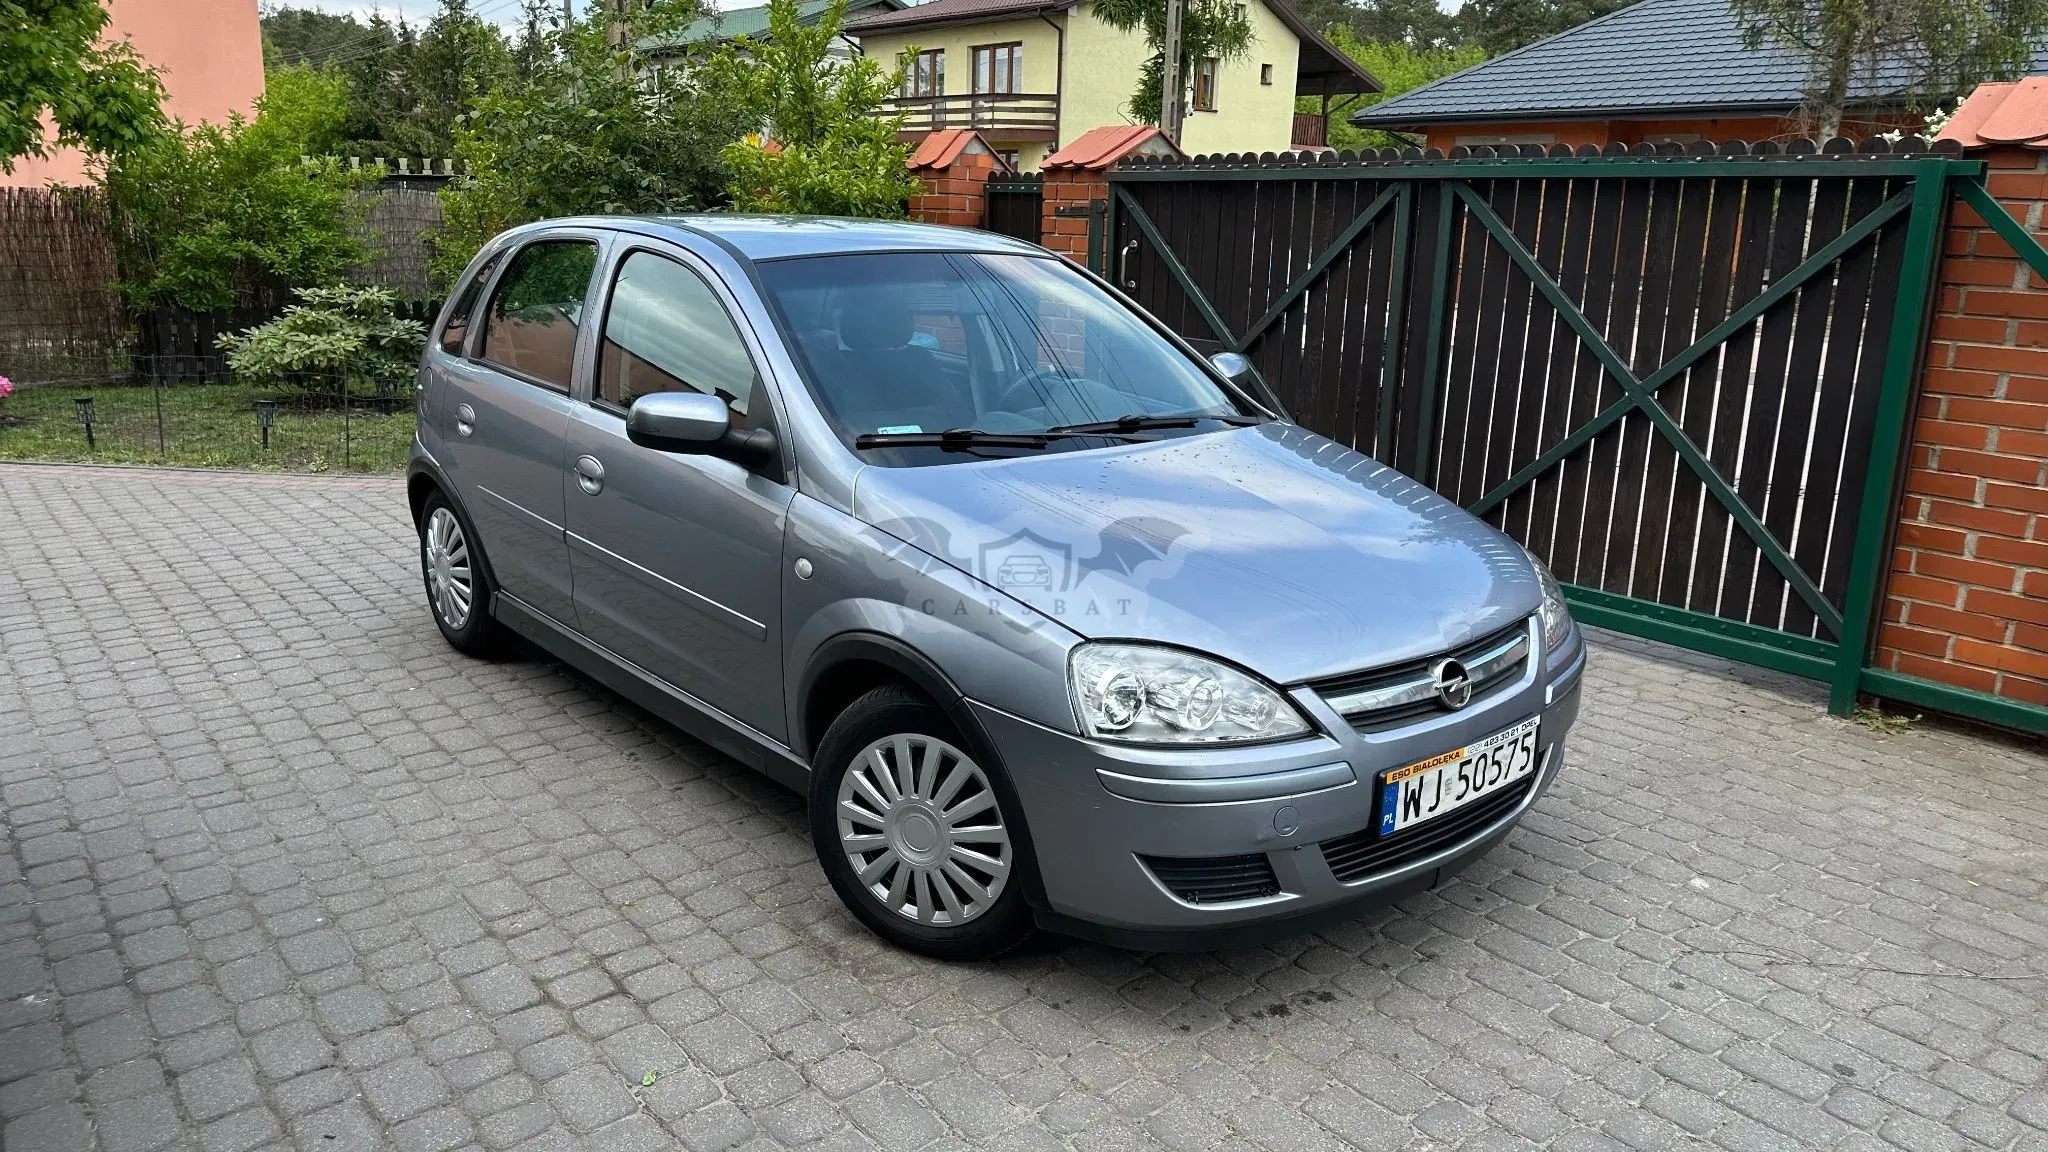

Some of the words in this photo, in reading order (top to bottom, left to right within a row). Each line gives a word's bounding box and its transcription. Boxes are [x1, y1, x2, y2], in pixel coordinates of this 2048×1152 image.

[1392, 768, 1411, 780] ESO
[1413, 751, 1460, 774] BIAŁOŁĘKA
[1484, 736, 1499, 747] 423
[1500, 731, 1510, 741] 30
[1511, 727, 1519, 736] 21
[1521, 719, 1537, 731] OPEL
[1403, 769, 1442, 823] WJ
[1455, 731, 1533, 801] 50575
[1383, 812, 1394, 826] PL
